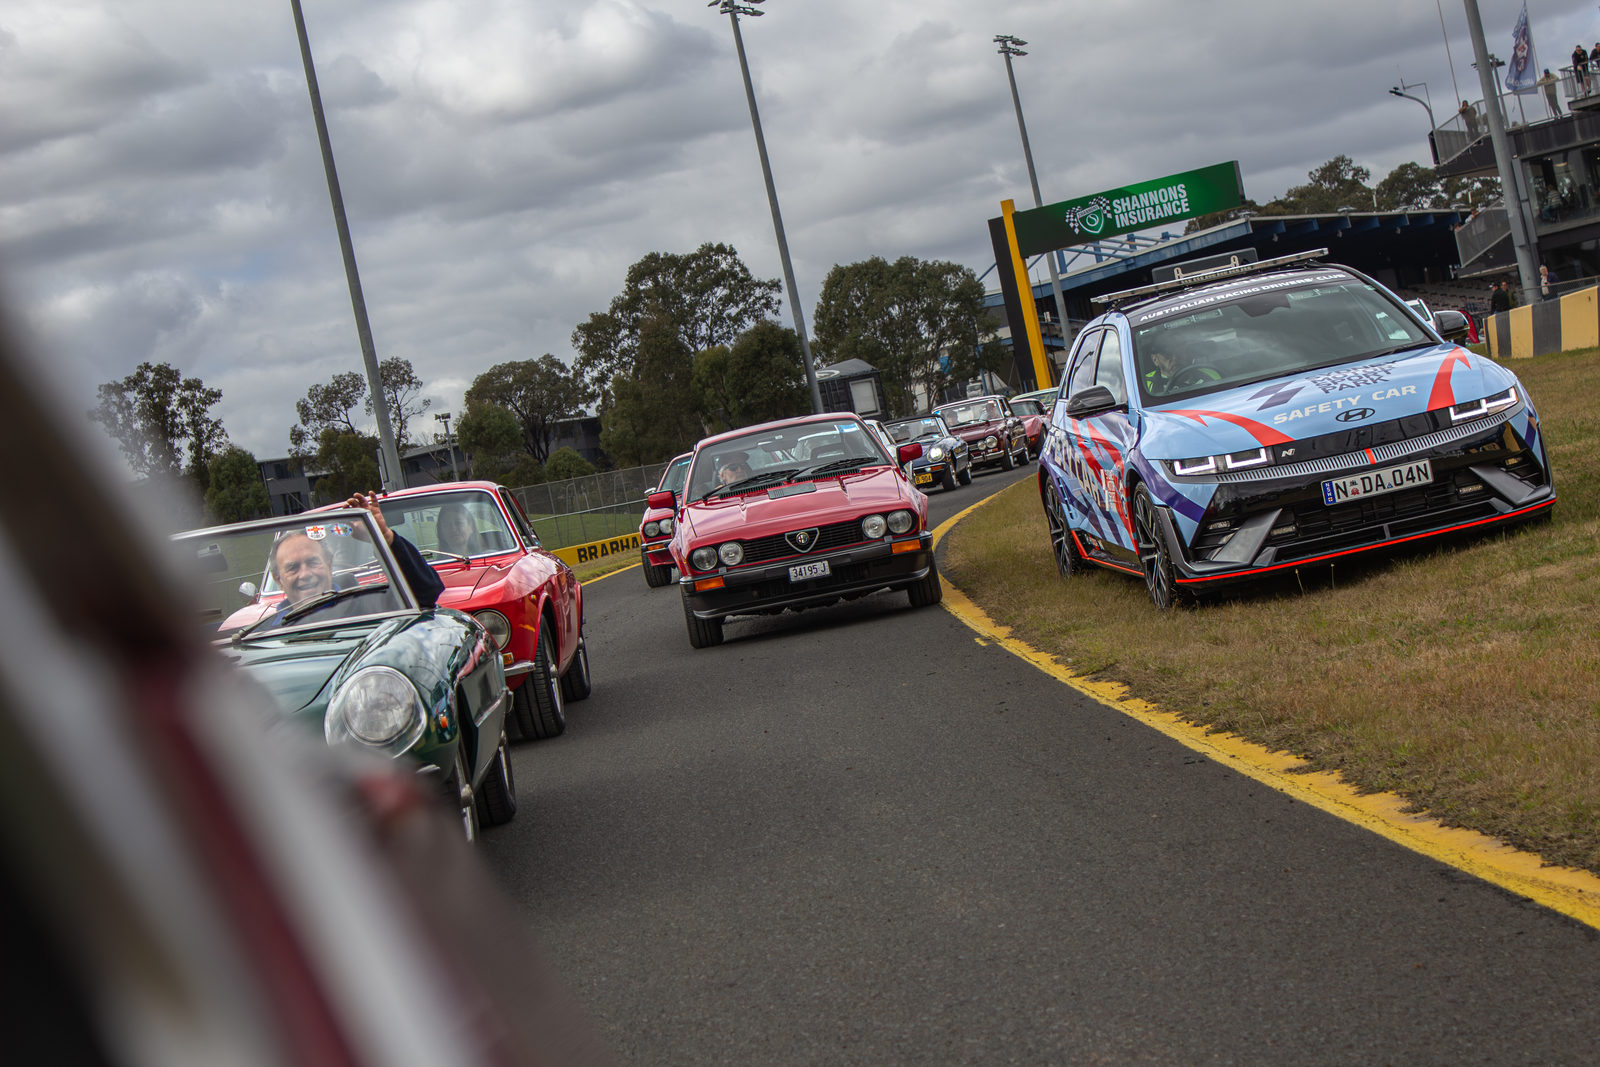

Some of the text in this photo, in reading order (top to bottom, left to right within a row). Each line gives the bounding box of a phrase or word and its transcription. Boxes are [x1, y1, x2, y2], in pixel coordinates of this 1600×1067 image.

[1113, 183, 1187, 214] SHANNONS
[1114, 198, 1190, 228] INSURANCE
[1140, 297, 1215, 321] AUSTRALIAN
[1214, 287, 1260, 302] RACING
[1260, 277, 1315, 291] DRIVERS'
[1316, 273, 1347, 281] CLUB
[1319, 374, 1390, 394] PARK
[1273, 385, 1417, 425] SAFETY CAR
[576, 536, 640, 563] BRABHA
